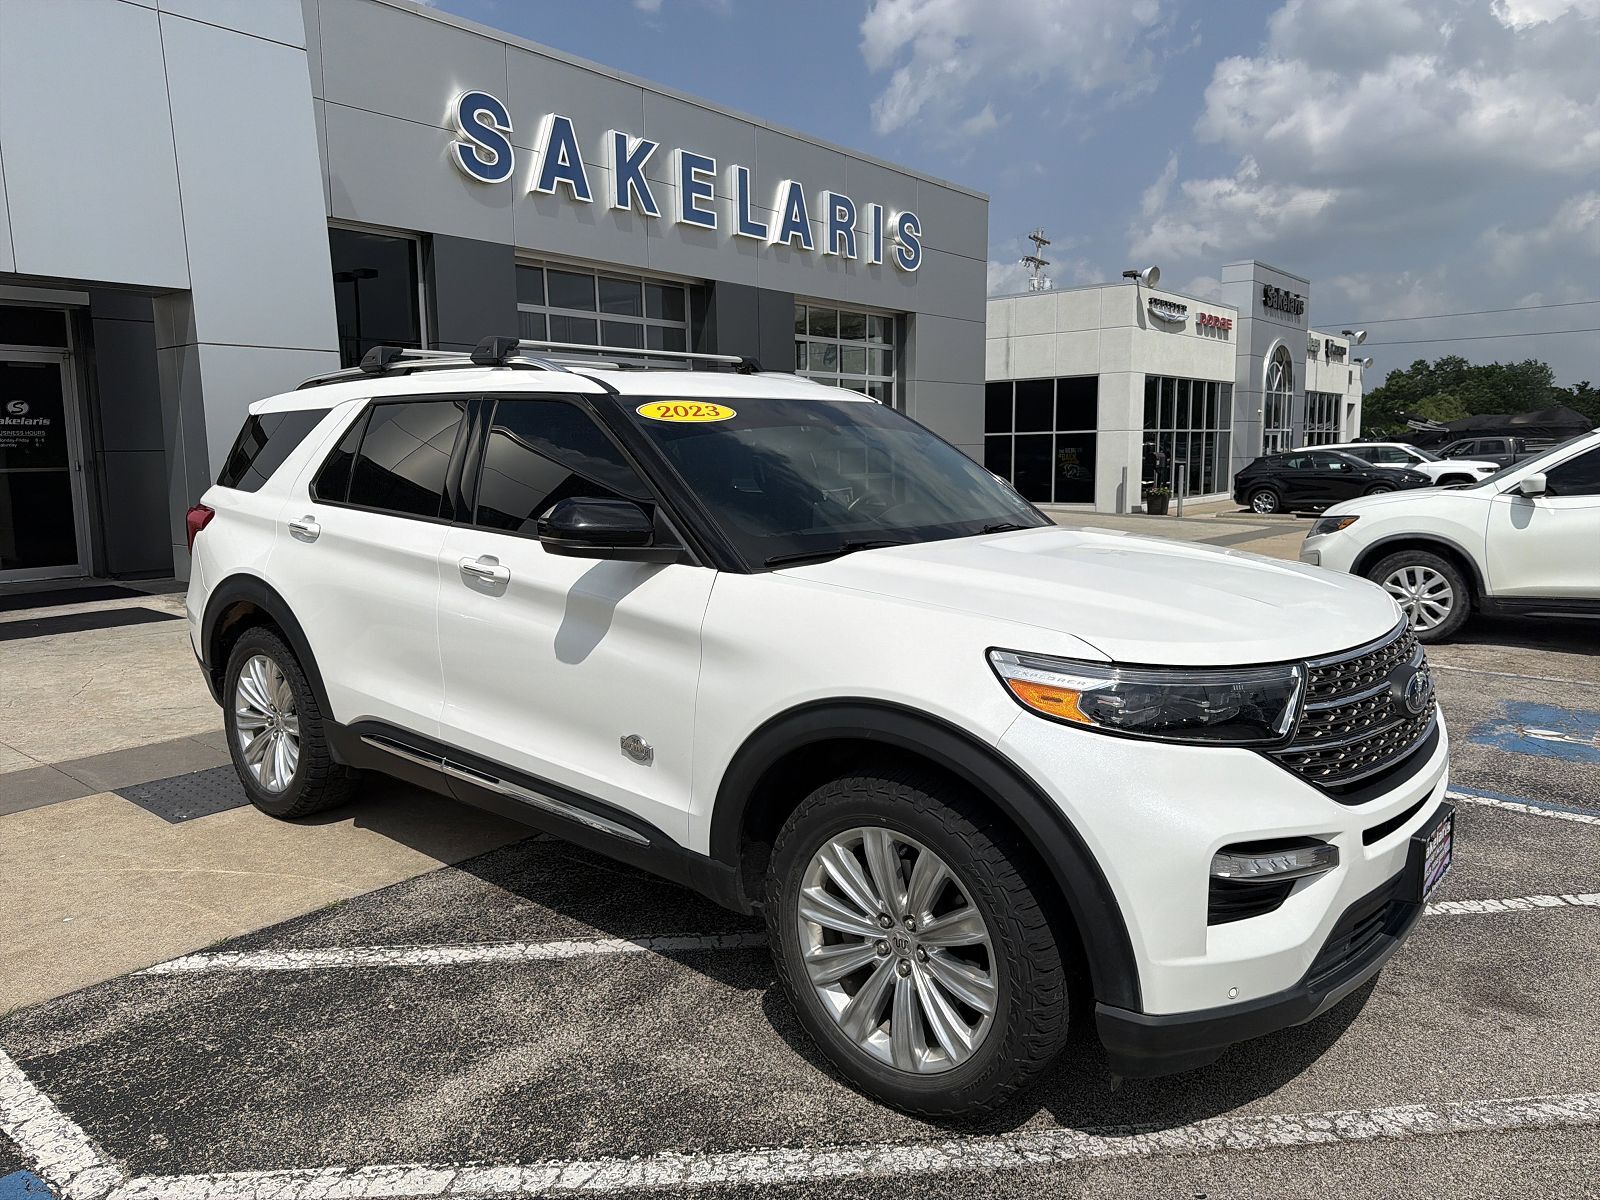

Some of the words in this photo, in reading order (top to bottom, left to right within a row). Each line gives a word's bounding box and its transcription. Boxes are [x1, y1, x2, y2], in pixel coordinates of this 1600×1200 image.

[450, 88, 923, 272] SAKELARIS
[1264, 284, 1304, 315] Sakelaris
[1198, 312, 1232, 330] DODGE
[656, 405, 720, 418] 2023
[0, 417, 50, 425] akelaris
